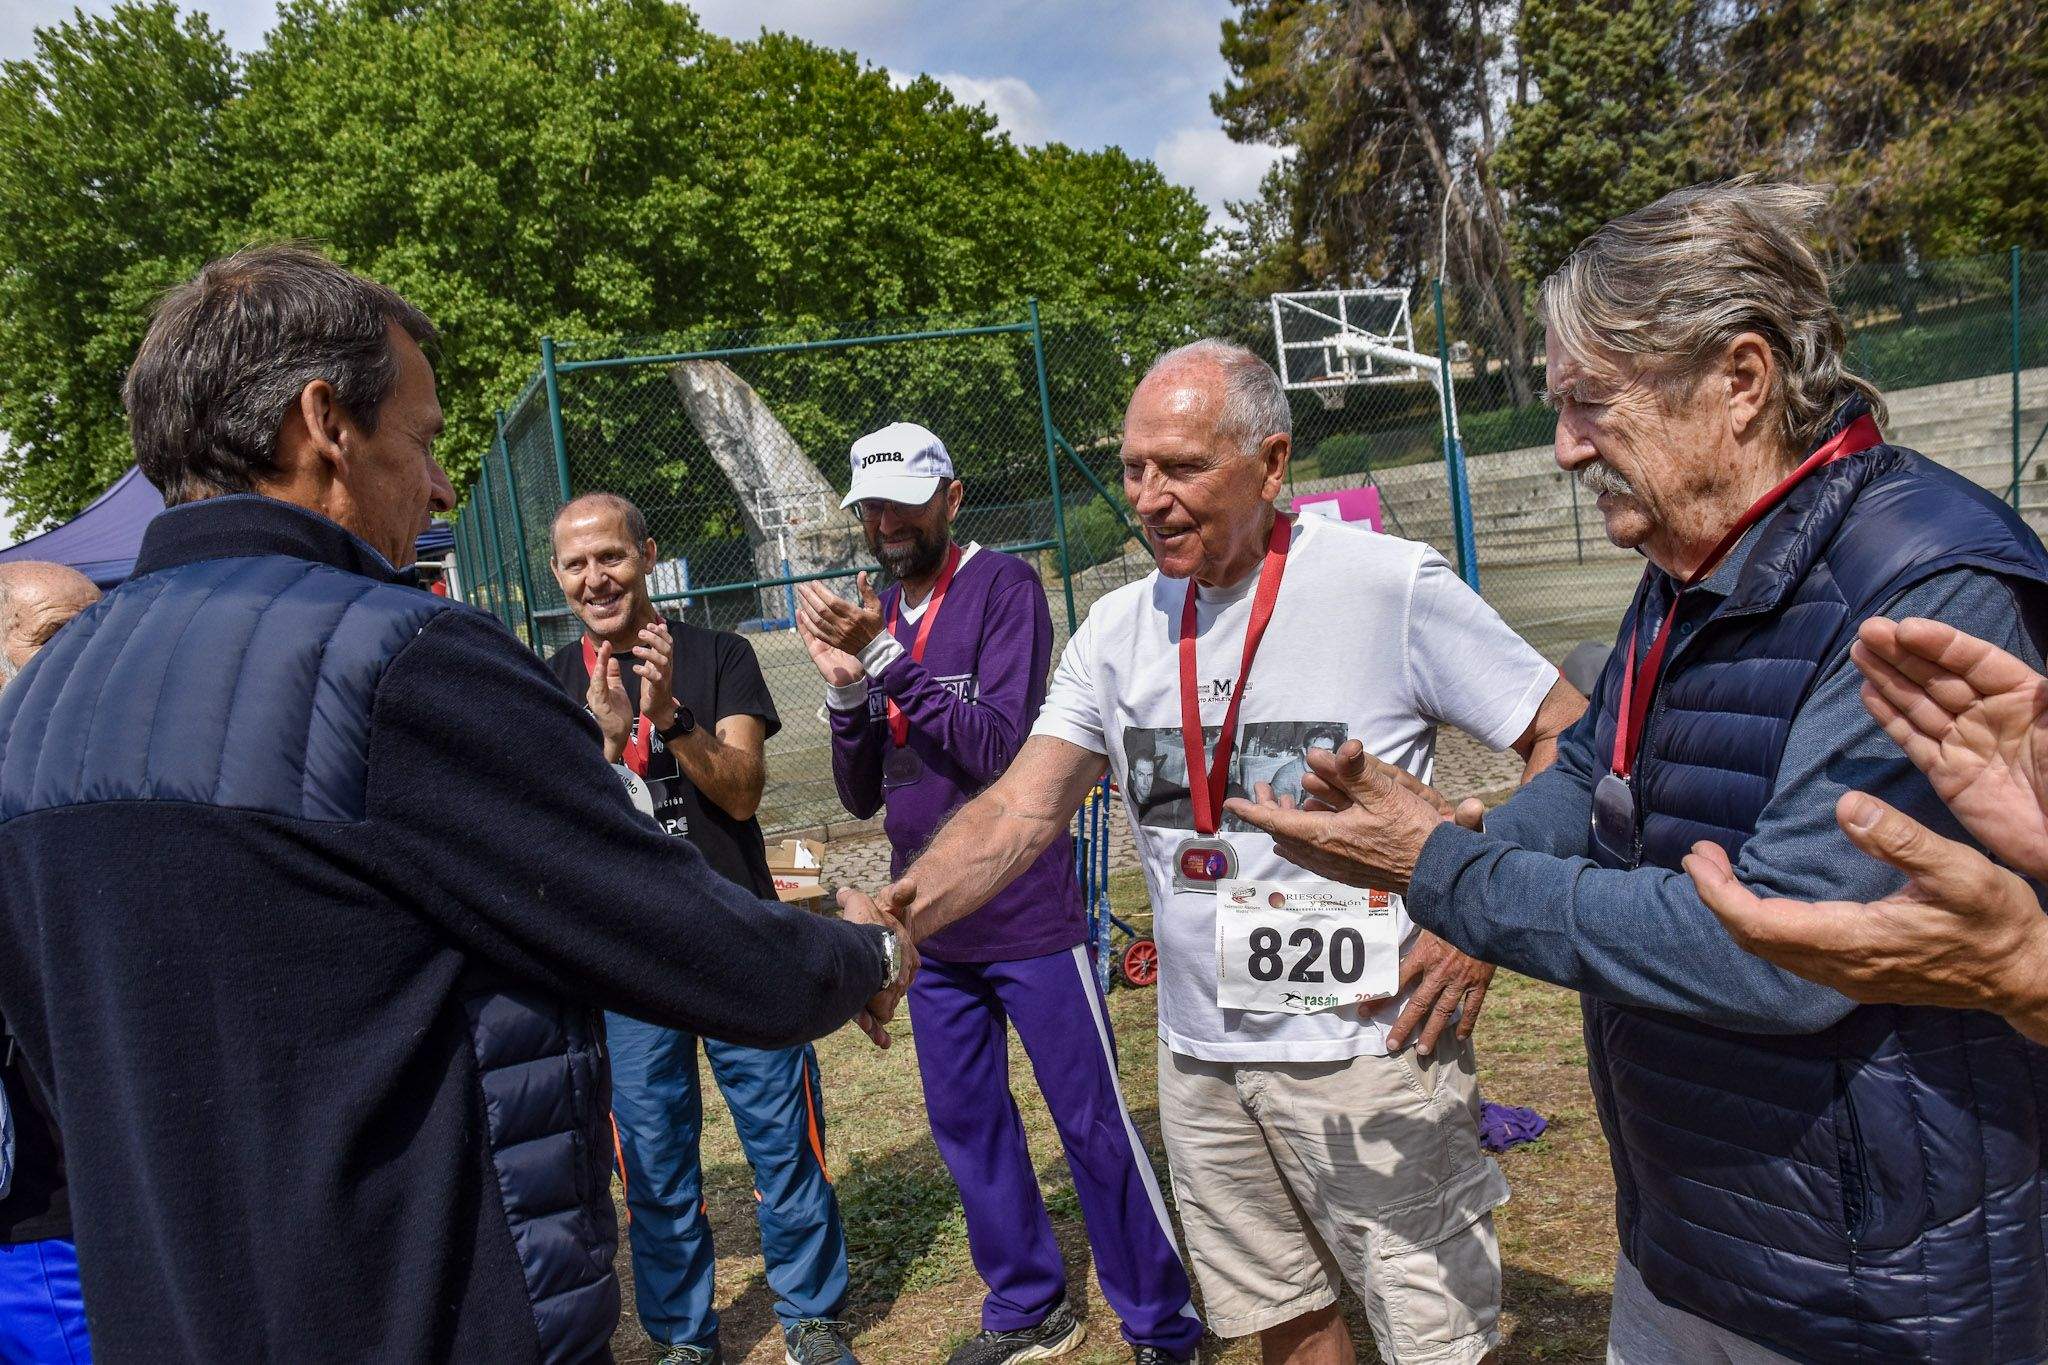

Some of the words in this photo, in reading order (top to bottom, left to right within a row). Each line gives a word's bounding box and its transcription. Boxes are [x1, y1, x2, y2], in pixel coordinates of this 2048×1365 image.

[1213, 679, 1231, 696] M
[1286, 893, 1333, 901] RIESGO
[1248, 926, 1366, 984] 820
